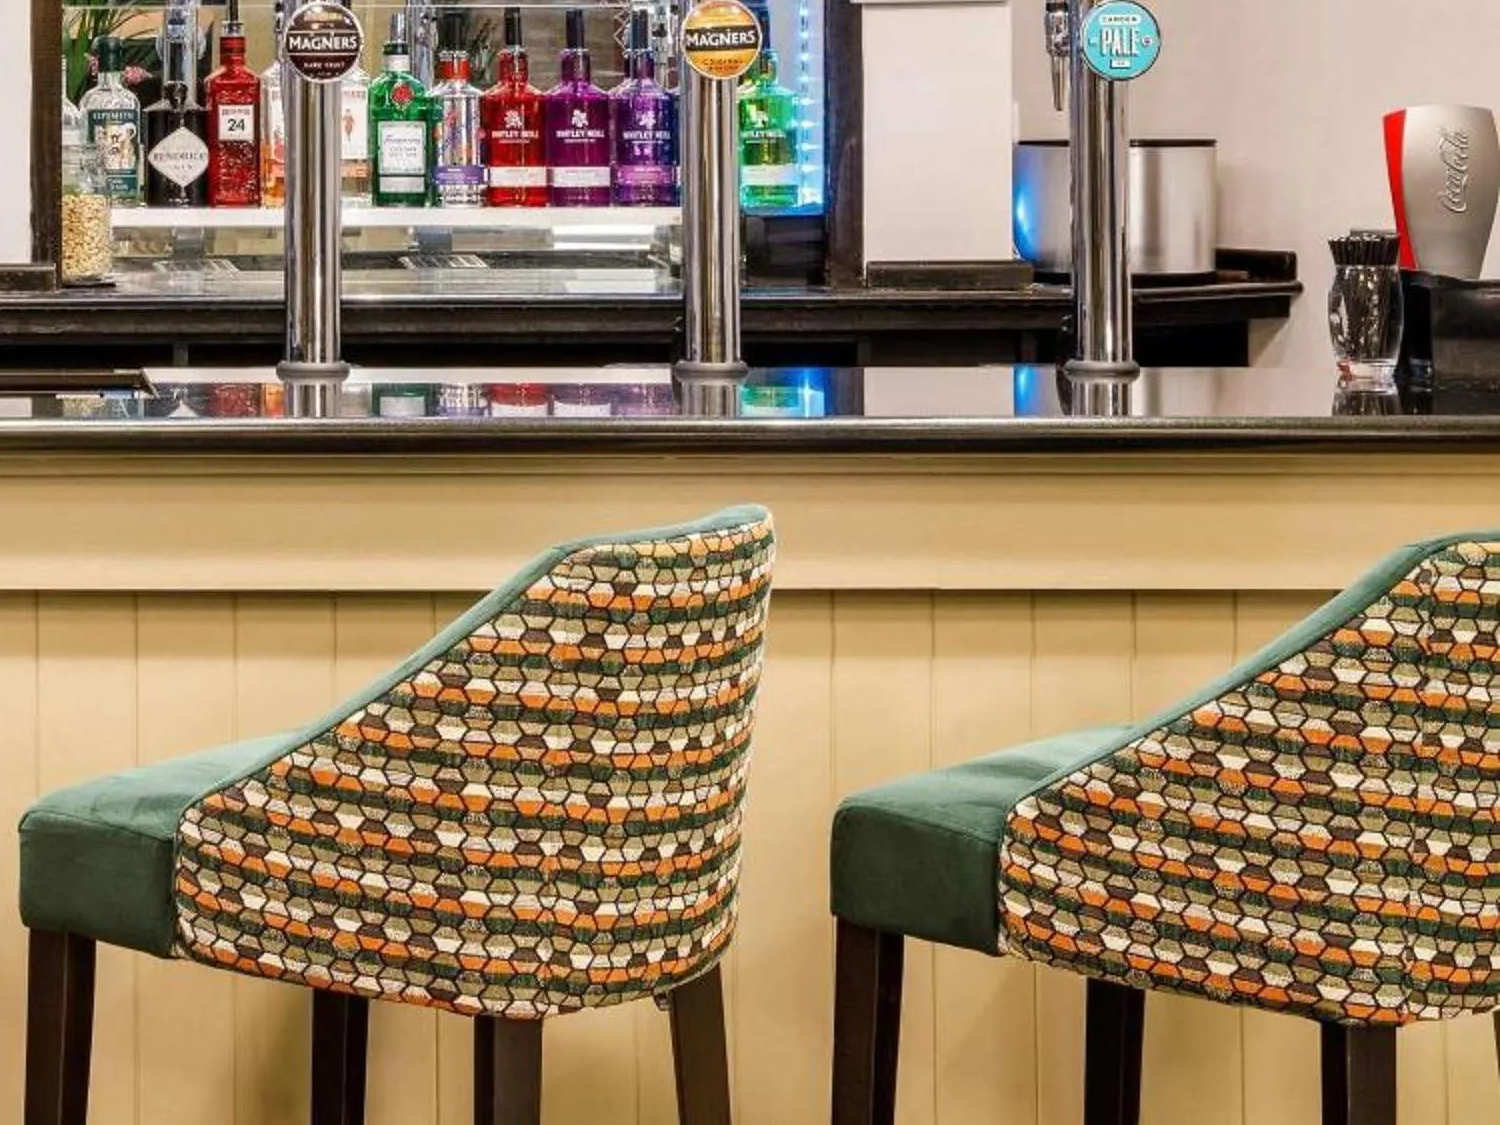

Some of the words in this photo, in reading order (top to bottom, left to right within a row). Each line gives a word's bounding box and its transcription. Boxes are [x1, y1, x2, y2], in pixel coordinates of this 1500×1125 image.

[289, 36, 358, 50] MAGNERS
[687, 30, 756, 47] MAGNERS
[1101, 27, 1141, 57] PALE
[227, 118, 246, 132] 24
